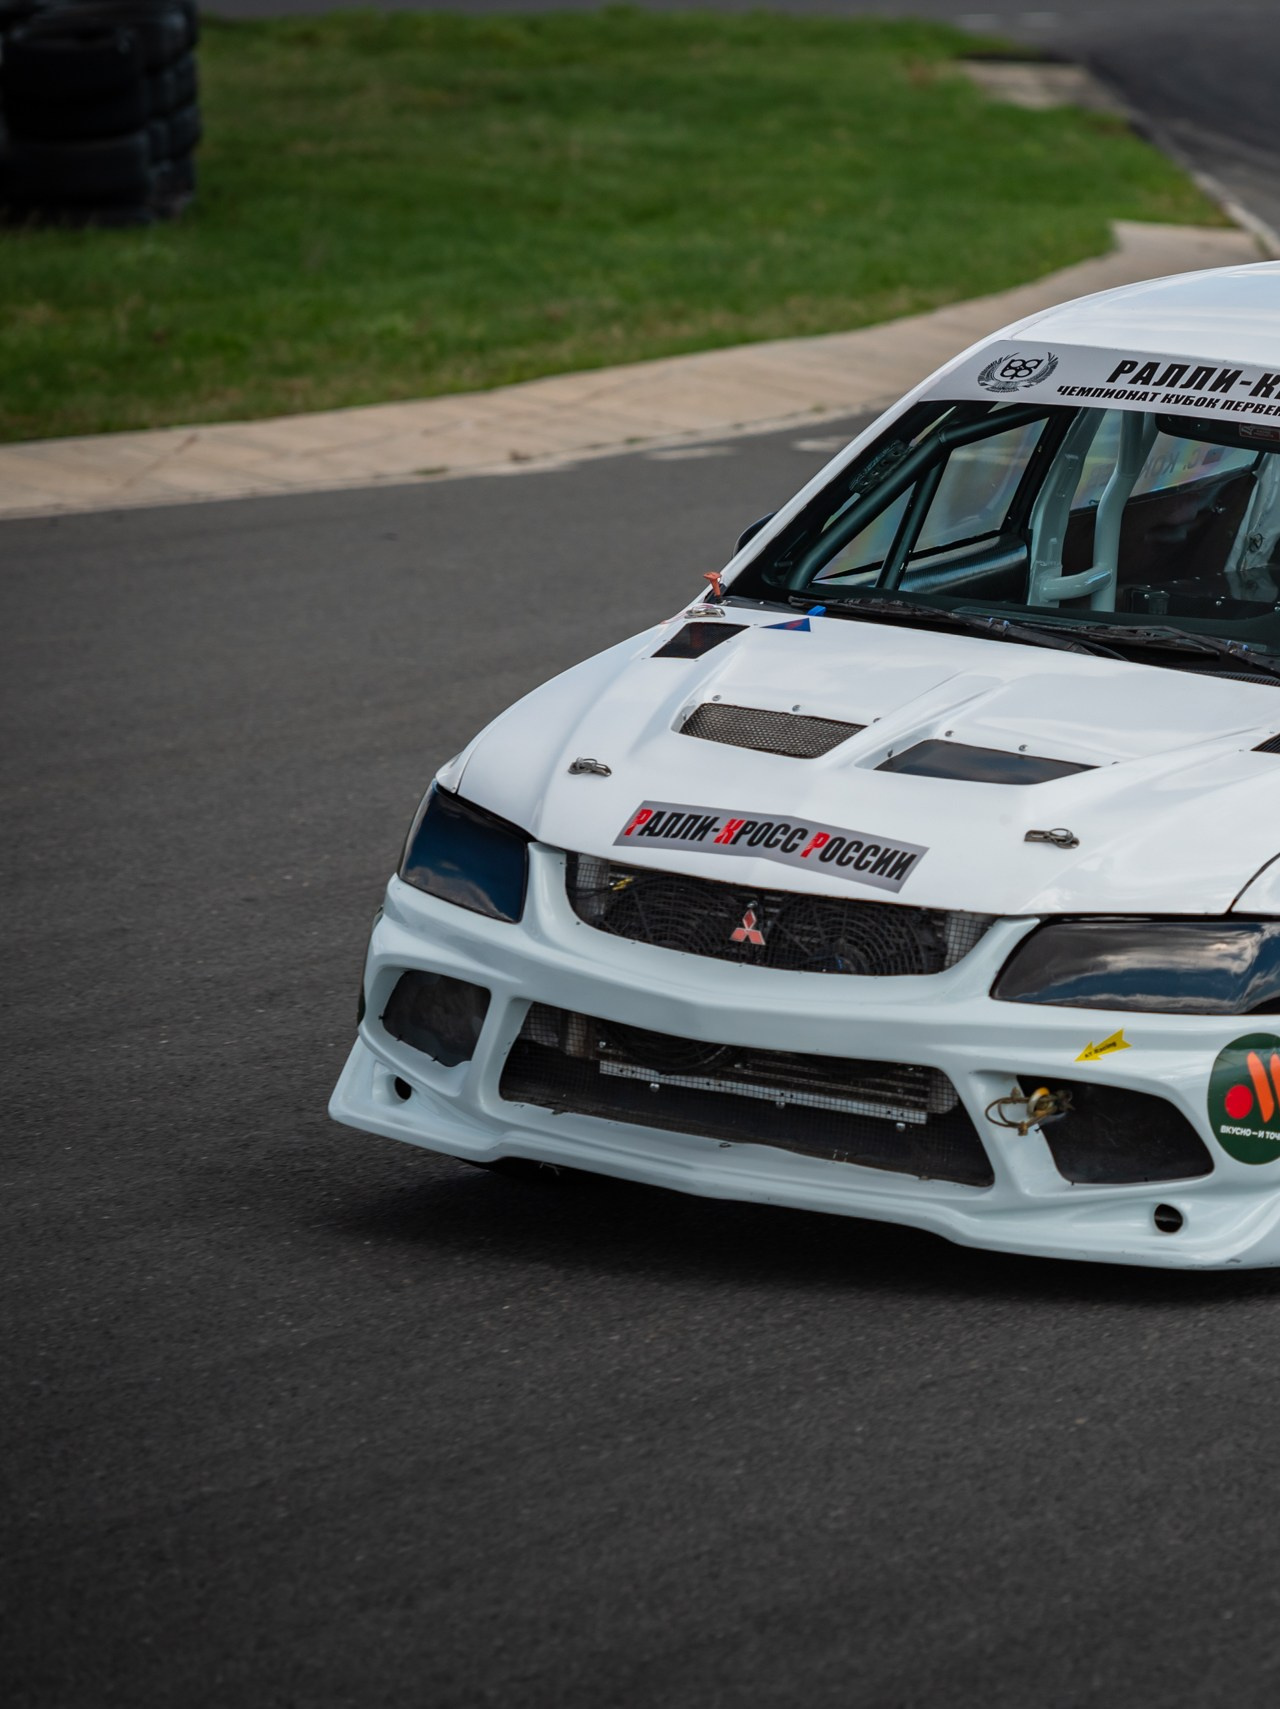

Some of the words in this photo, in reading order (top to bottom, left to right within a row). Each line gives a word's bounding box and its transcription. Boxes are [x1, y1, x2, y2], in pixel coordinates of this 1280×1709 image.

[1057, 385, 1161, 402] ЧЕМПИОНАТ
[1160, 394, 1221, 408] КУБОК
[624, 809, 808, 853] РАЛЛИ-КРОСС
[800, 832, 918, 880] РОССИИ
